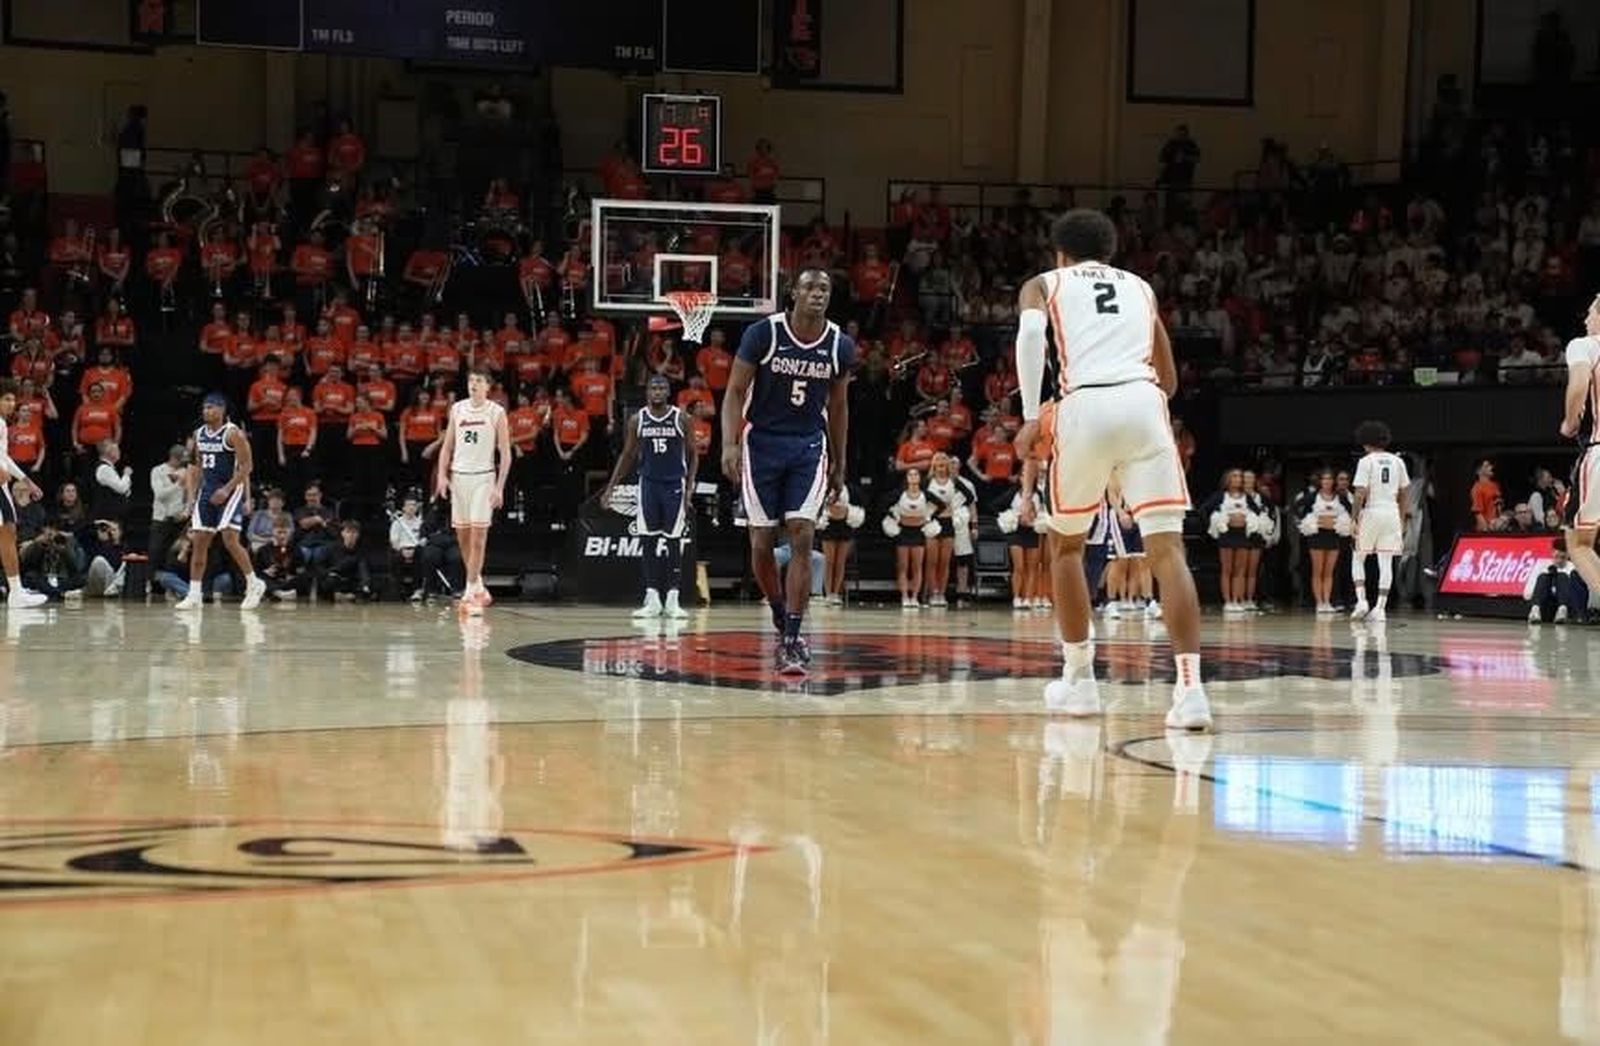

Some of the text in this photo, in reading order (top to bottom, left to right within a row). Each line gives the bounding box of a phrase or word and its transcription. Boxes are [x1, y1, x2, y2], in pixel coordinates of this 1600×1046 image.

[446, 10, 494, 26] PERIOD
[659, 127, 702, 164] 26
[1093, 282, 1119, 314] 2
[771, 356, 831, 379] GONZAGA
[790, 380, 807, 406] 5
[464, 430, 478, 443] 24
[652, 438, 667, 453] 15
[1381, 467, 1390, 484] 0
